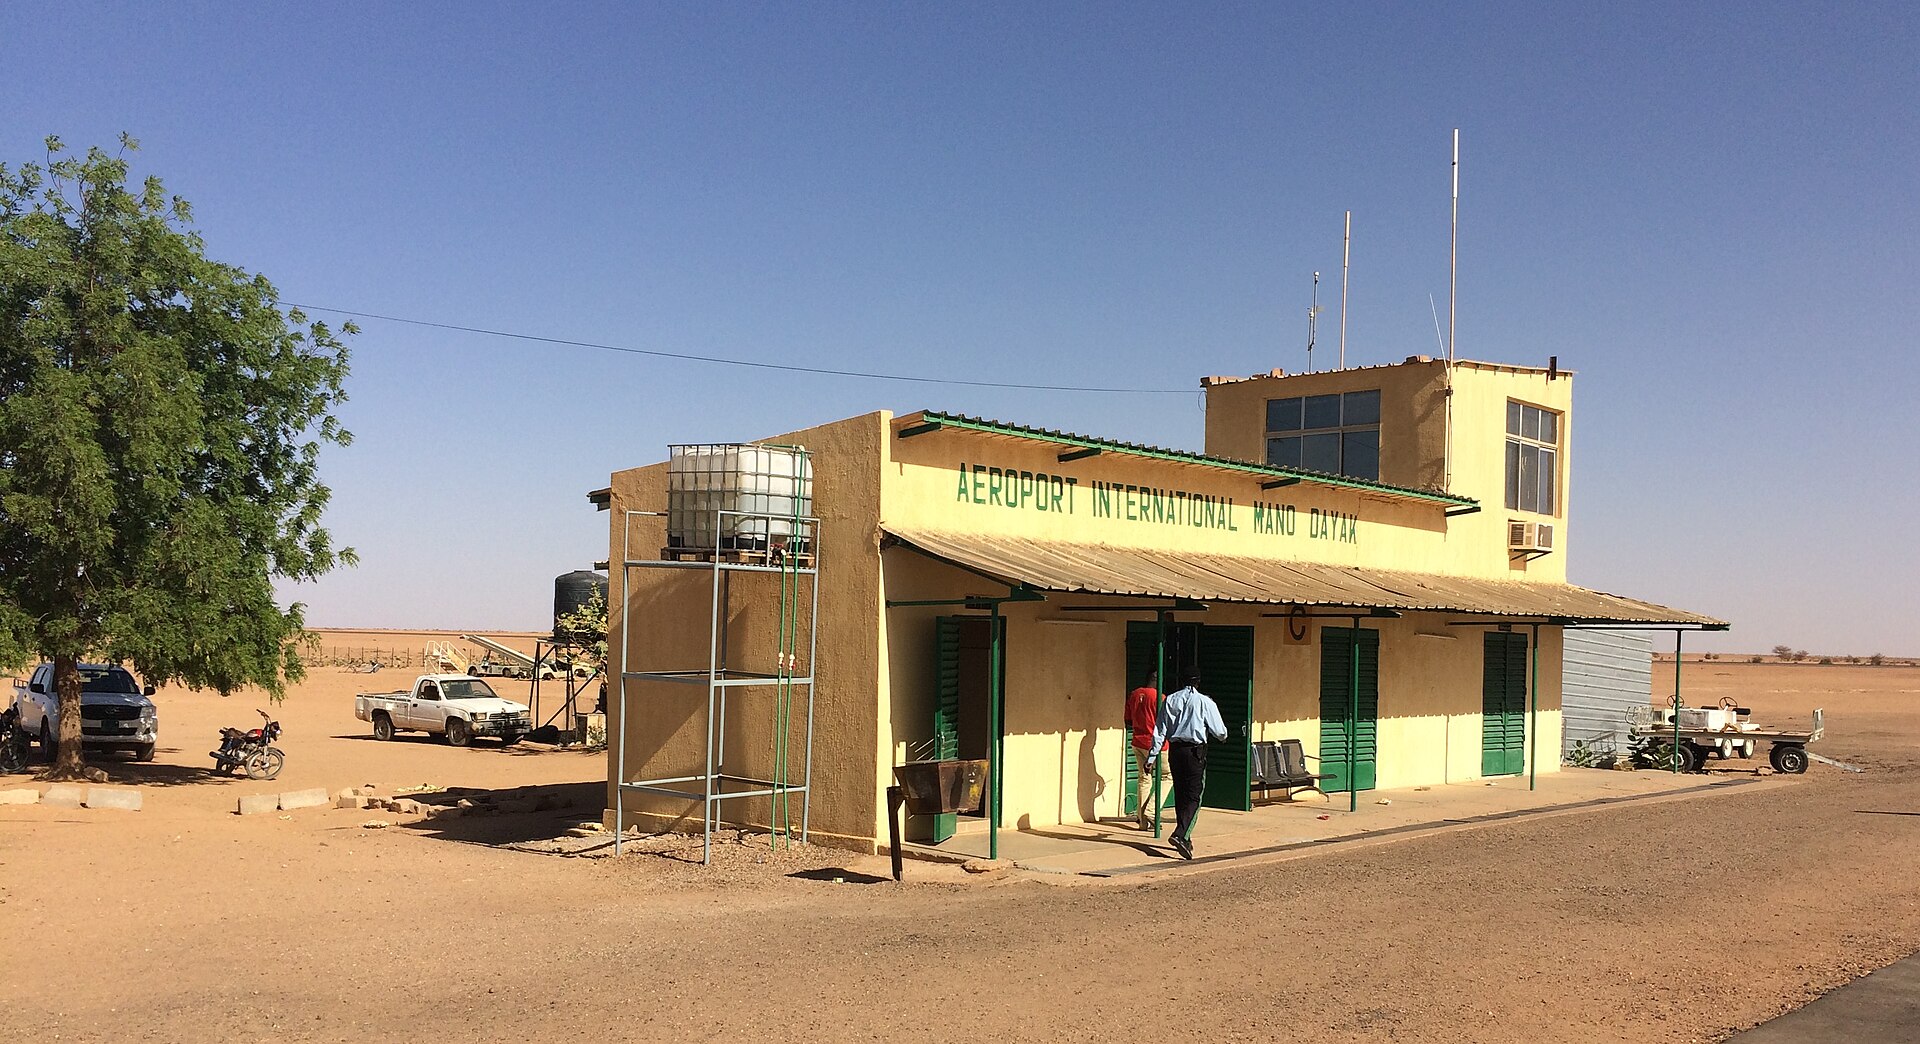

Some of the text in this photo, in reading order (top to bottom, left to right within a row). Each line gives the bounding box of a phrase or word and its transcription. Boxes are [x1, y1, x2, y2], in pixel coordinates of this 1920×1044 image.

[956, 462, 1358, 545] AEROPORT INTERNATIONAL MANO DAYAK
